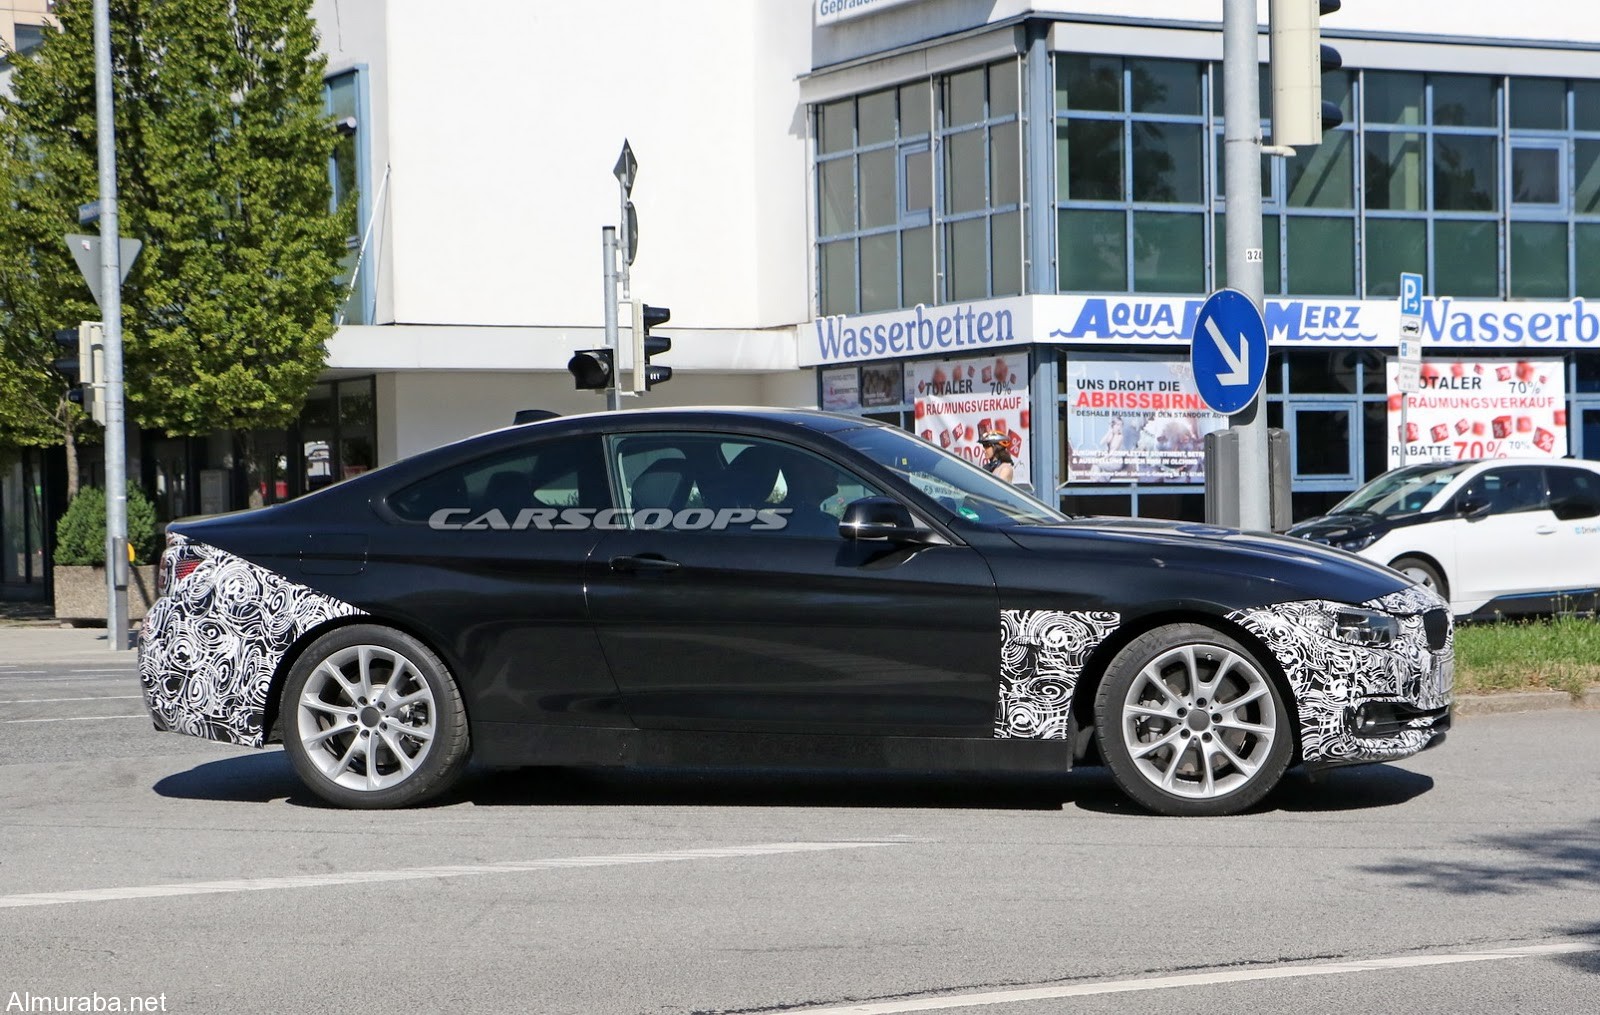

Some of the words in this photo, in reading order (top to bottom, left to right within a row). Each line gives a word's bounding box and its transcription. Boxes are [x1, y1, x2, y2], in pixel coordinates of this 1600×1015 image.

[1404, 279, 1416, 310] P
[1070, 298, 1175, 339] AQUA
[1265, 301, 1360, 341] MERZ
[816, 305, 1014, 360] Wasserbetten
[925, 379, 973, 396] TOTALER
[990, 381, 1012, 396] 70%
[1076, 379, 1104, 390] UNS
[1109, 380, 1154, 391] DROHT
[1159, 381, 1180, 392] DIE
[1419, 376, 1482, 390] OTALER
[1508, 381, 1541, 394] 70%
[1076, 391, 1208, 410] ABRISSBIRN
[1076, 410, 1110, 418] DESHALB
[1158, 411, 1172, 419] DEN
[1453, 441, 1507, 459] 70%
